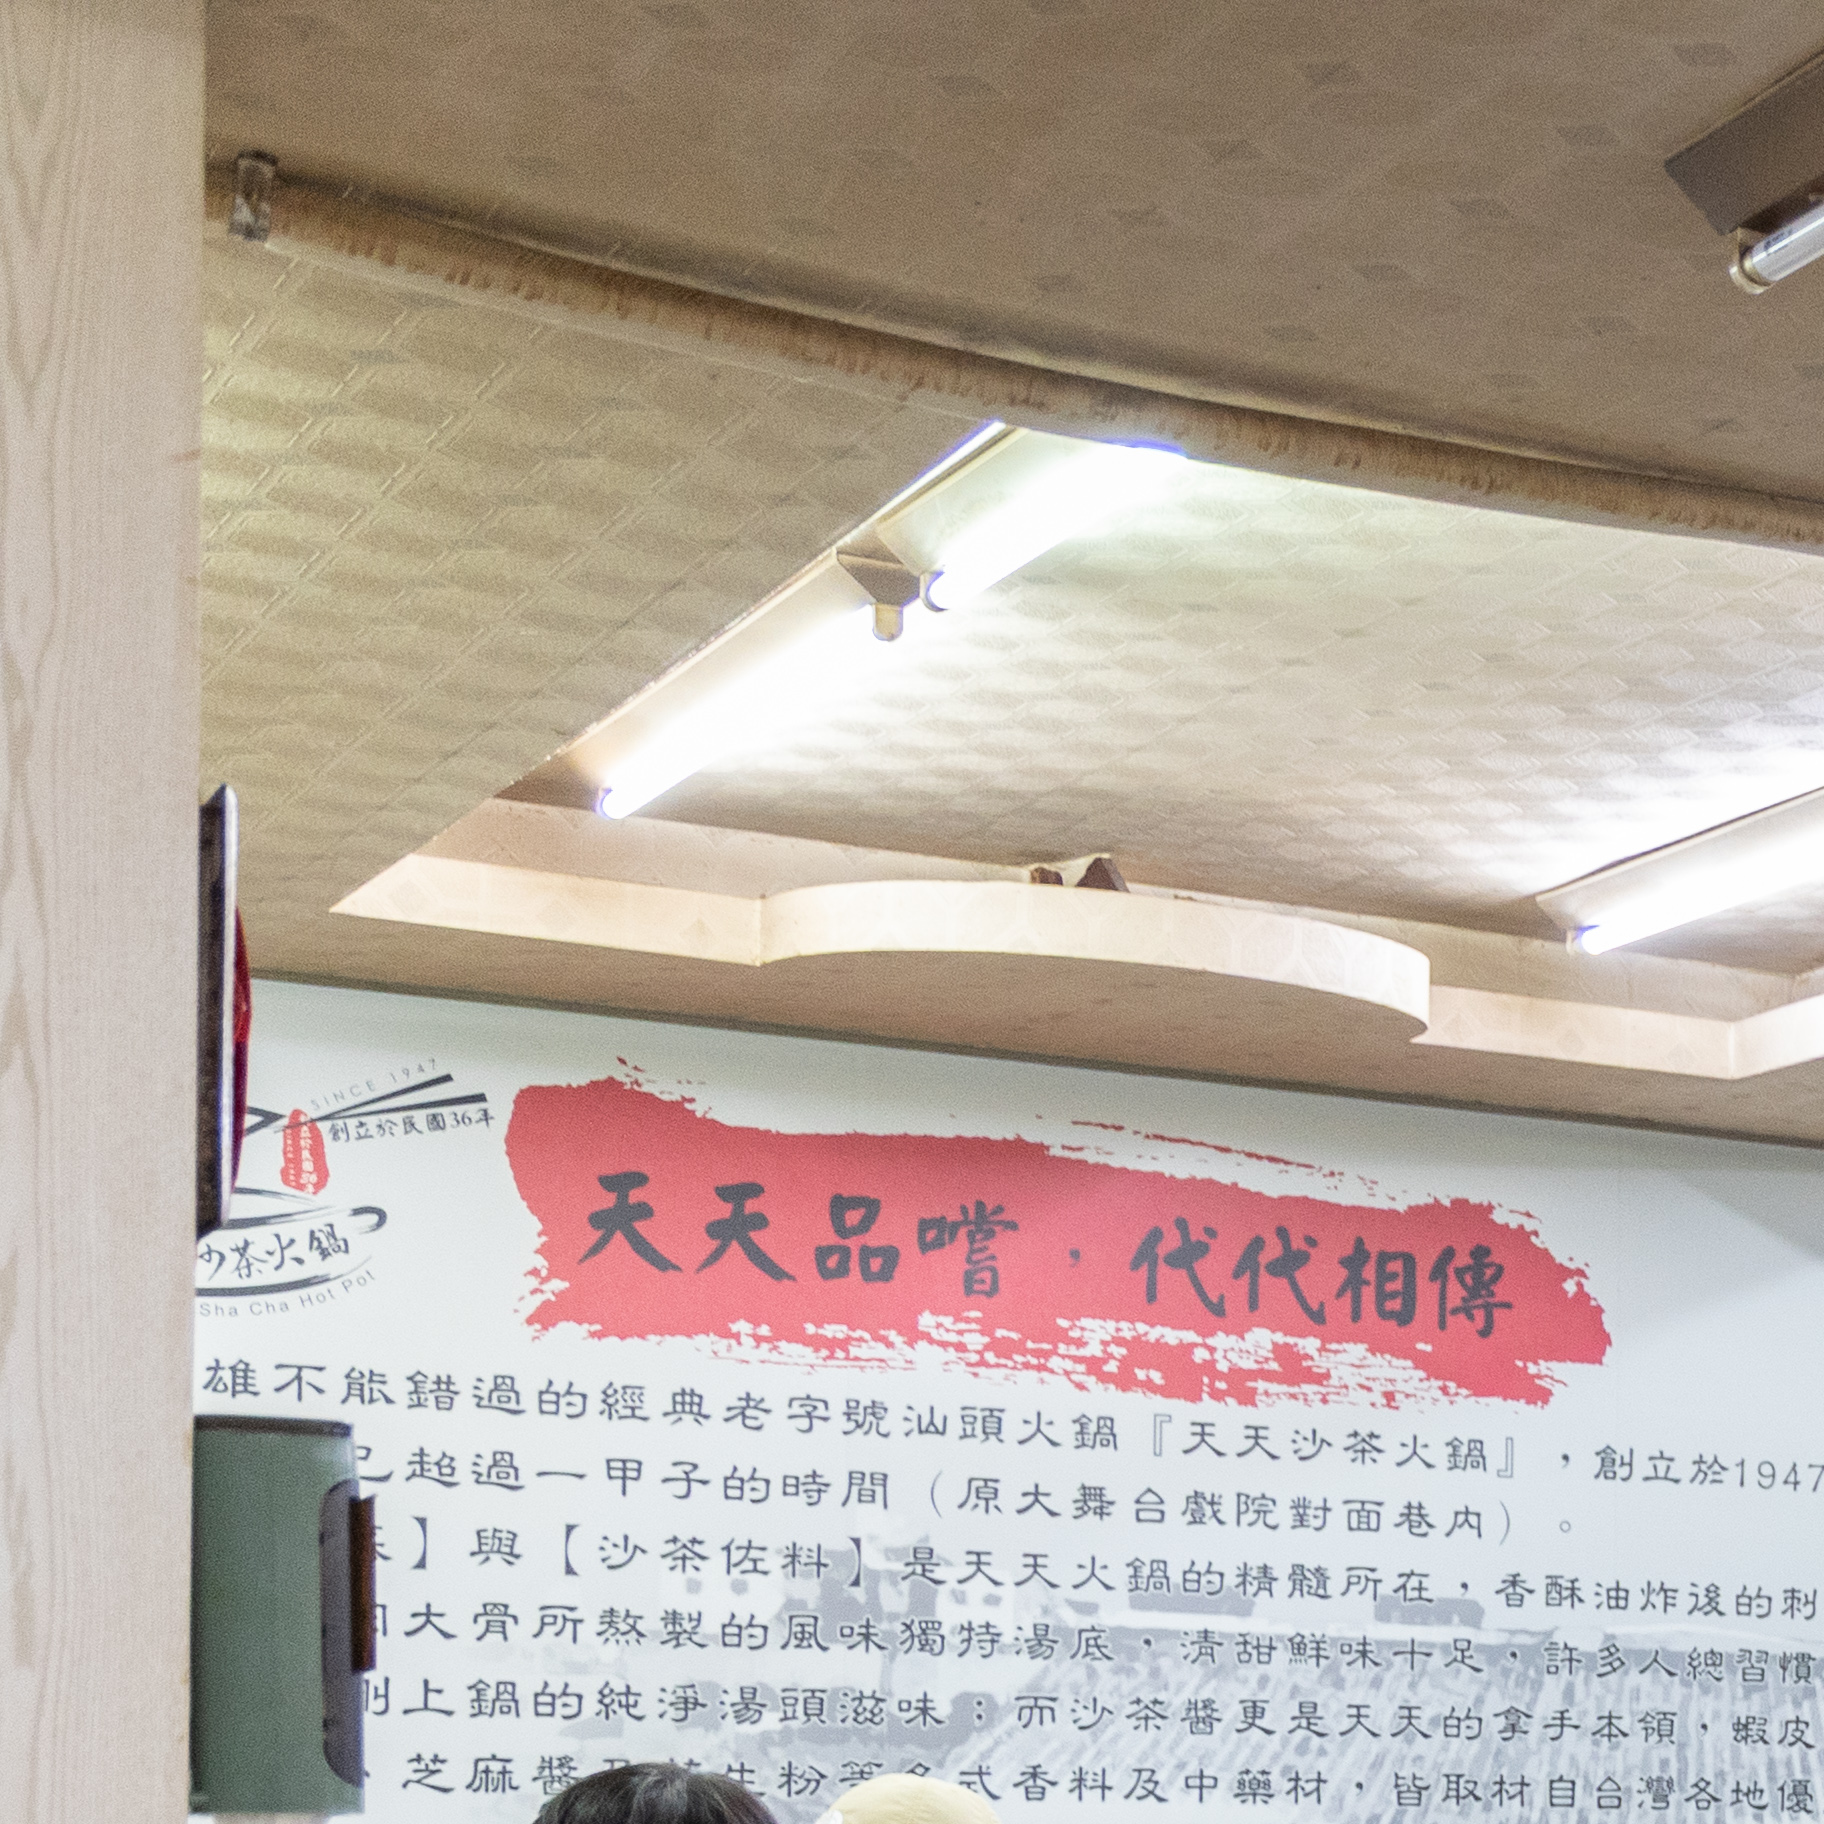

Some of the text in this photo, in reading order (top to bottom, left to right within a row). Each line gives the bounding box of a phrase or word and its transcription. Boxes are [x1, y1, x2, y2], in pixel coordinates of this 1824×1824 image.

[310, 1058, 438, 1111] SINCE 1947
[328, 1106, 496, 1142] 創立於民國36年
[199, 1269, 376, 1318] Sha Cha Hot Pot
